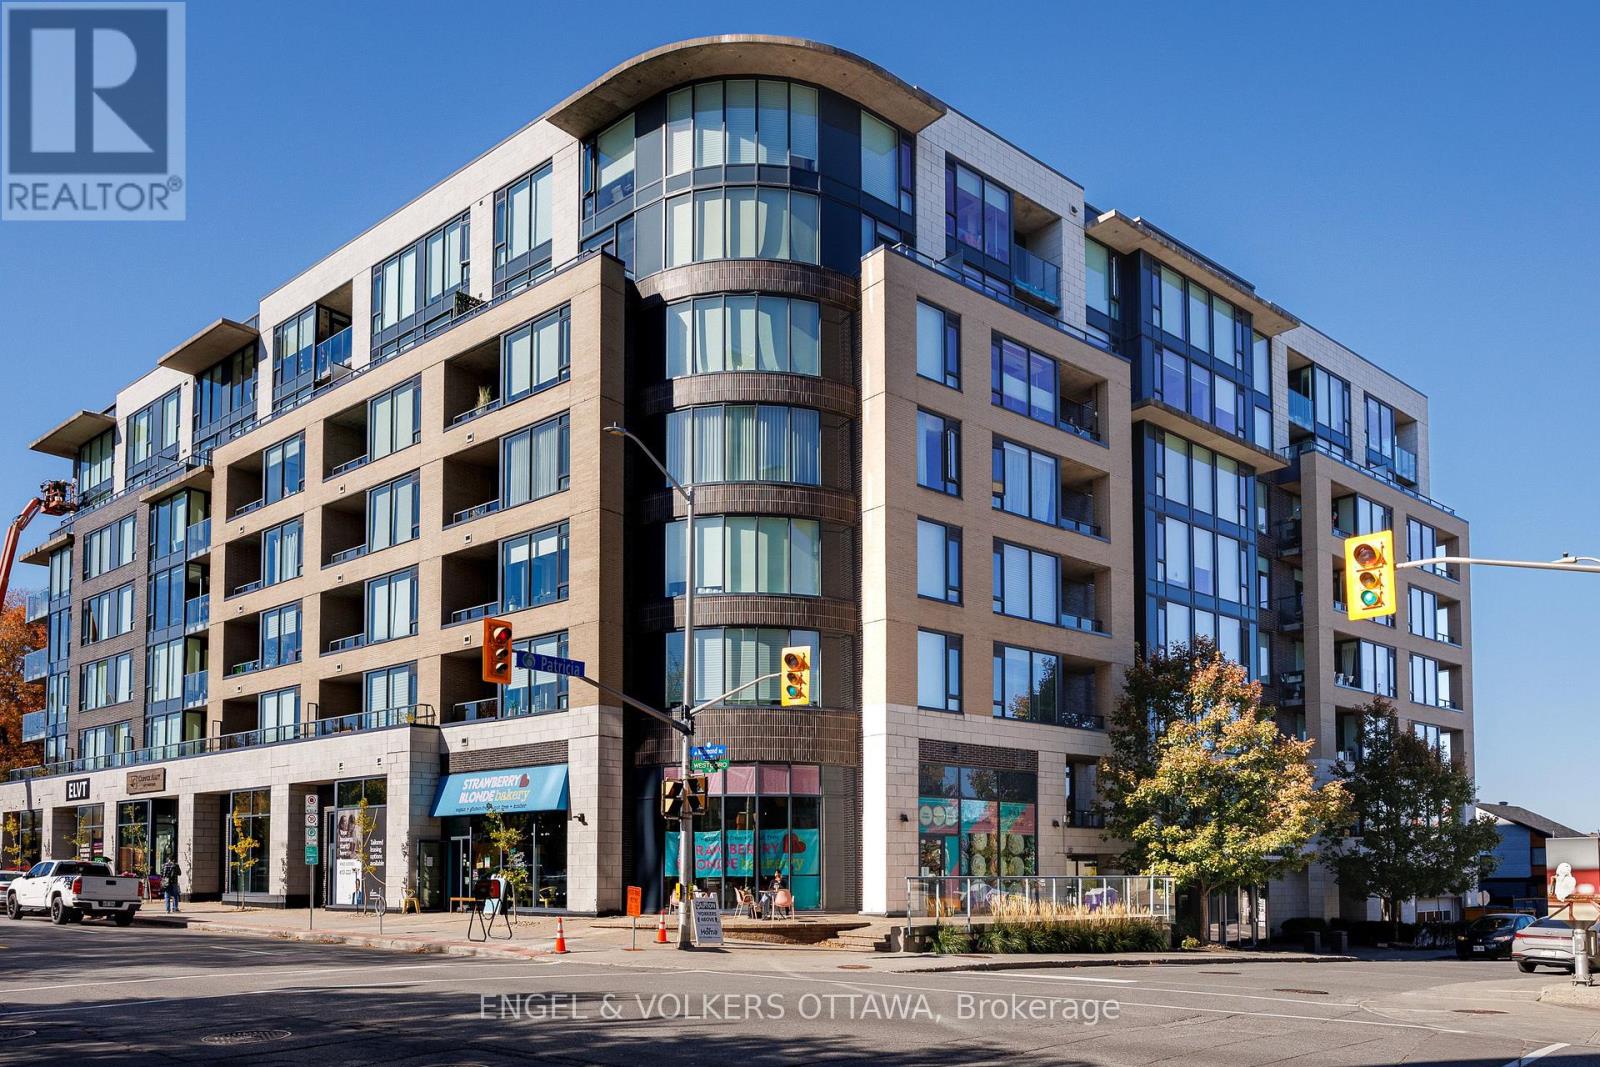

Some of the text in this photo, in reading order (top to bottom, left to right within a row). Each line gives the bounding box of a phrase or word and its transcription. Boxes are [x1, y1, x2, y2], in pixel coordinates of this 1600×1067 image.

[541, 656, 580, 675] Patricia
[68, 781, 88, 799] ELVT
[462, 774, 521, 790] STRAWBERRY
[458, 789, 529, 804] BLONDE bakery
